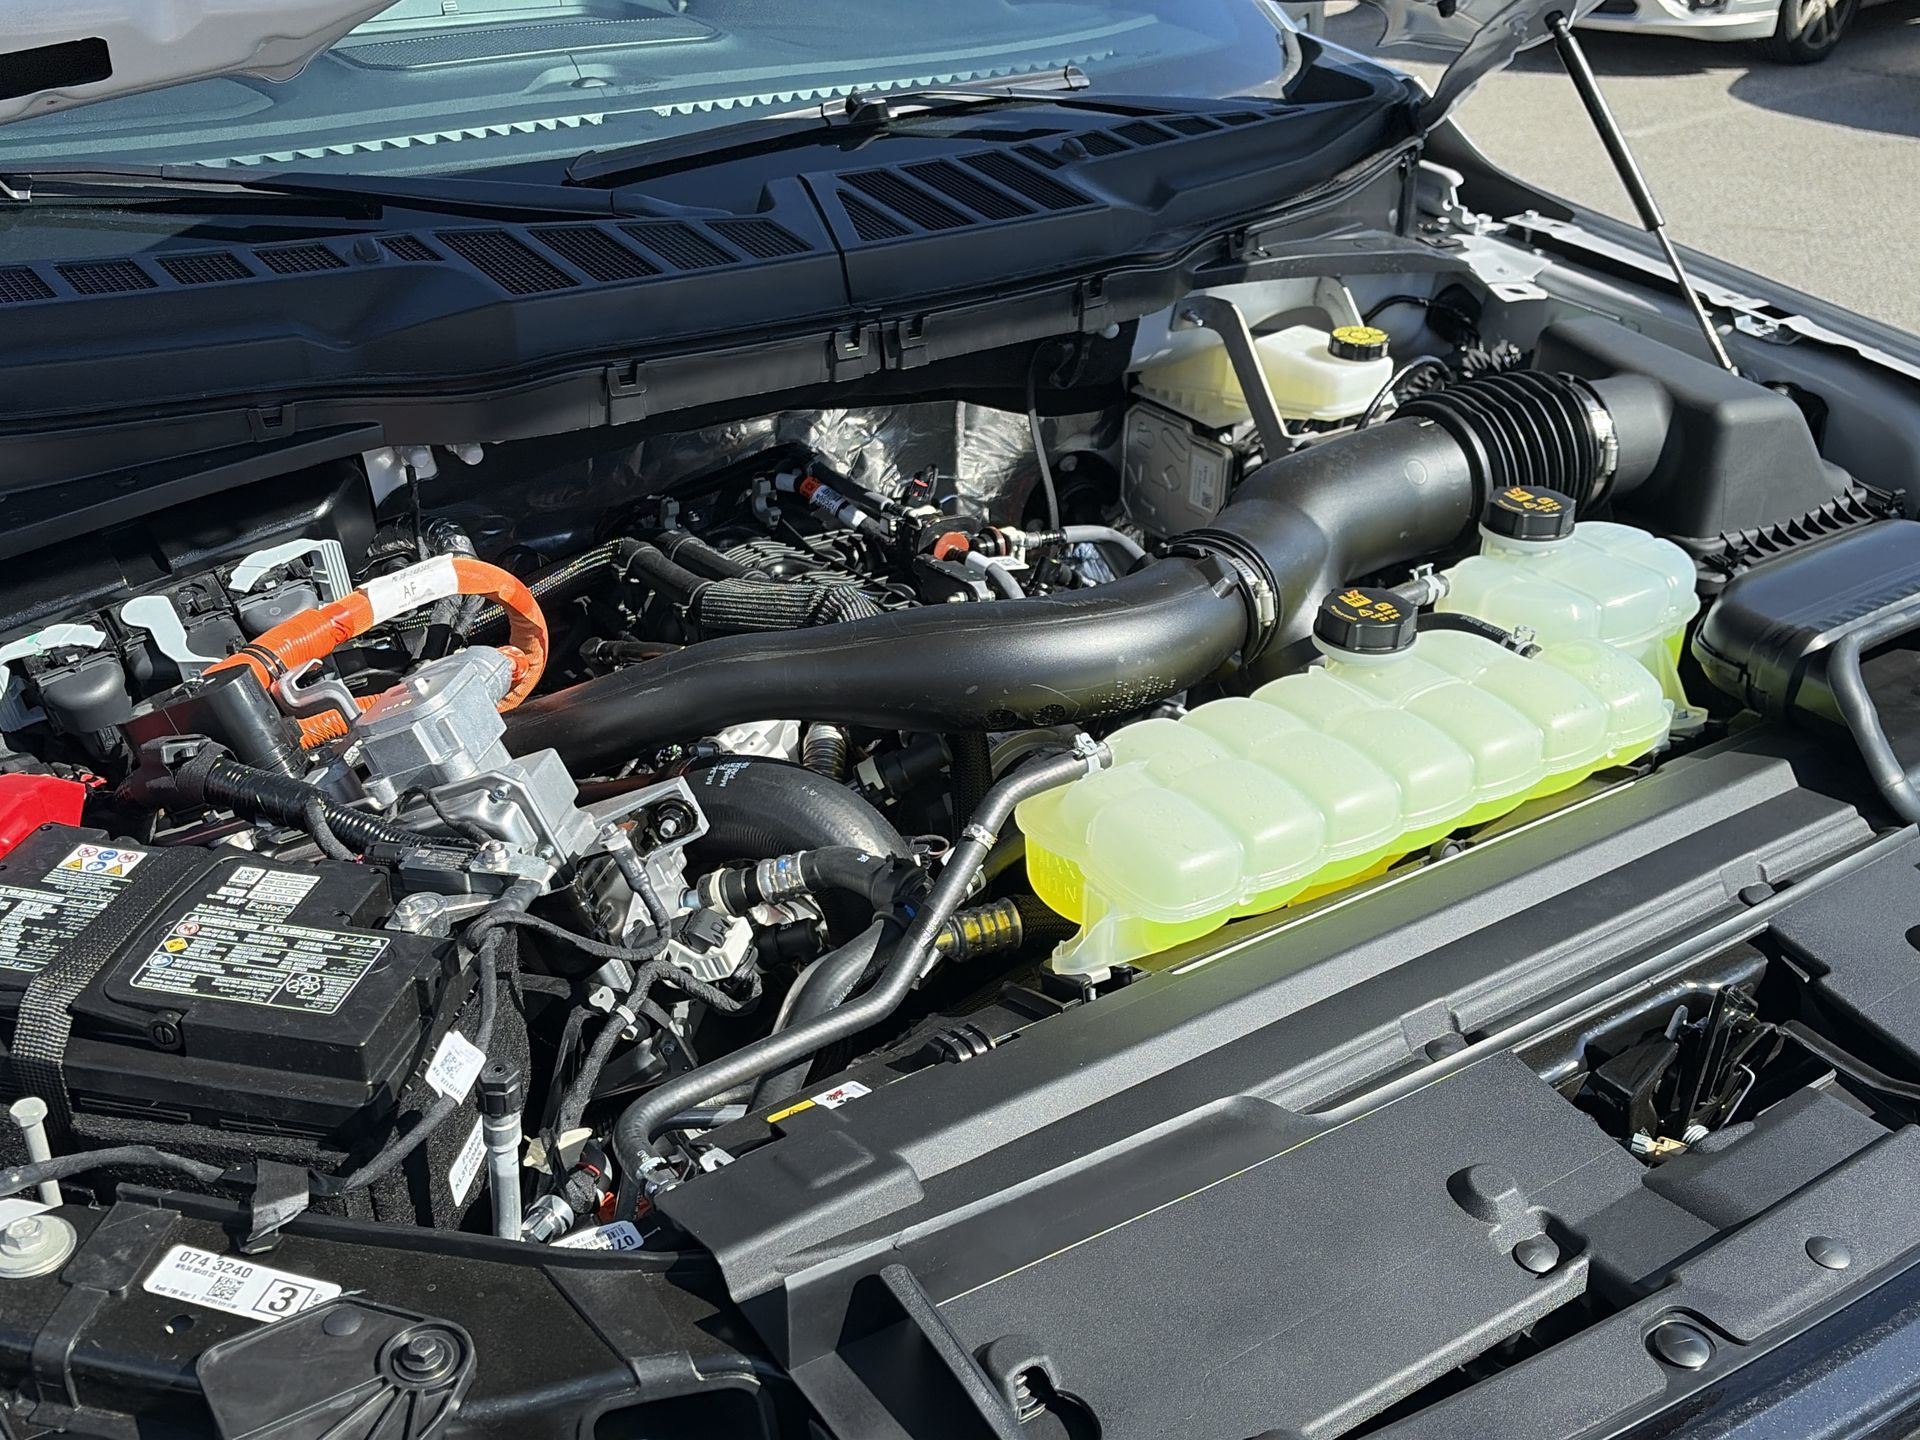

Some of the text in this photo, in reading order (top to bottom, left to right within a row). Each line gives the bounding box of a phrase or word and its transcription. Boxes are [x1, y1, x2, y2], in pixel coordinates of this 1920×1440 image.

[247, 901, 293, 913] FoMoCo
[179, 1251, 210, 1268] 074
[212, 1260, 253, 1279] 3240
[268, 1286, 299, 1312] 3
